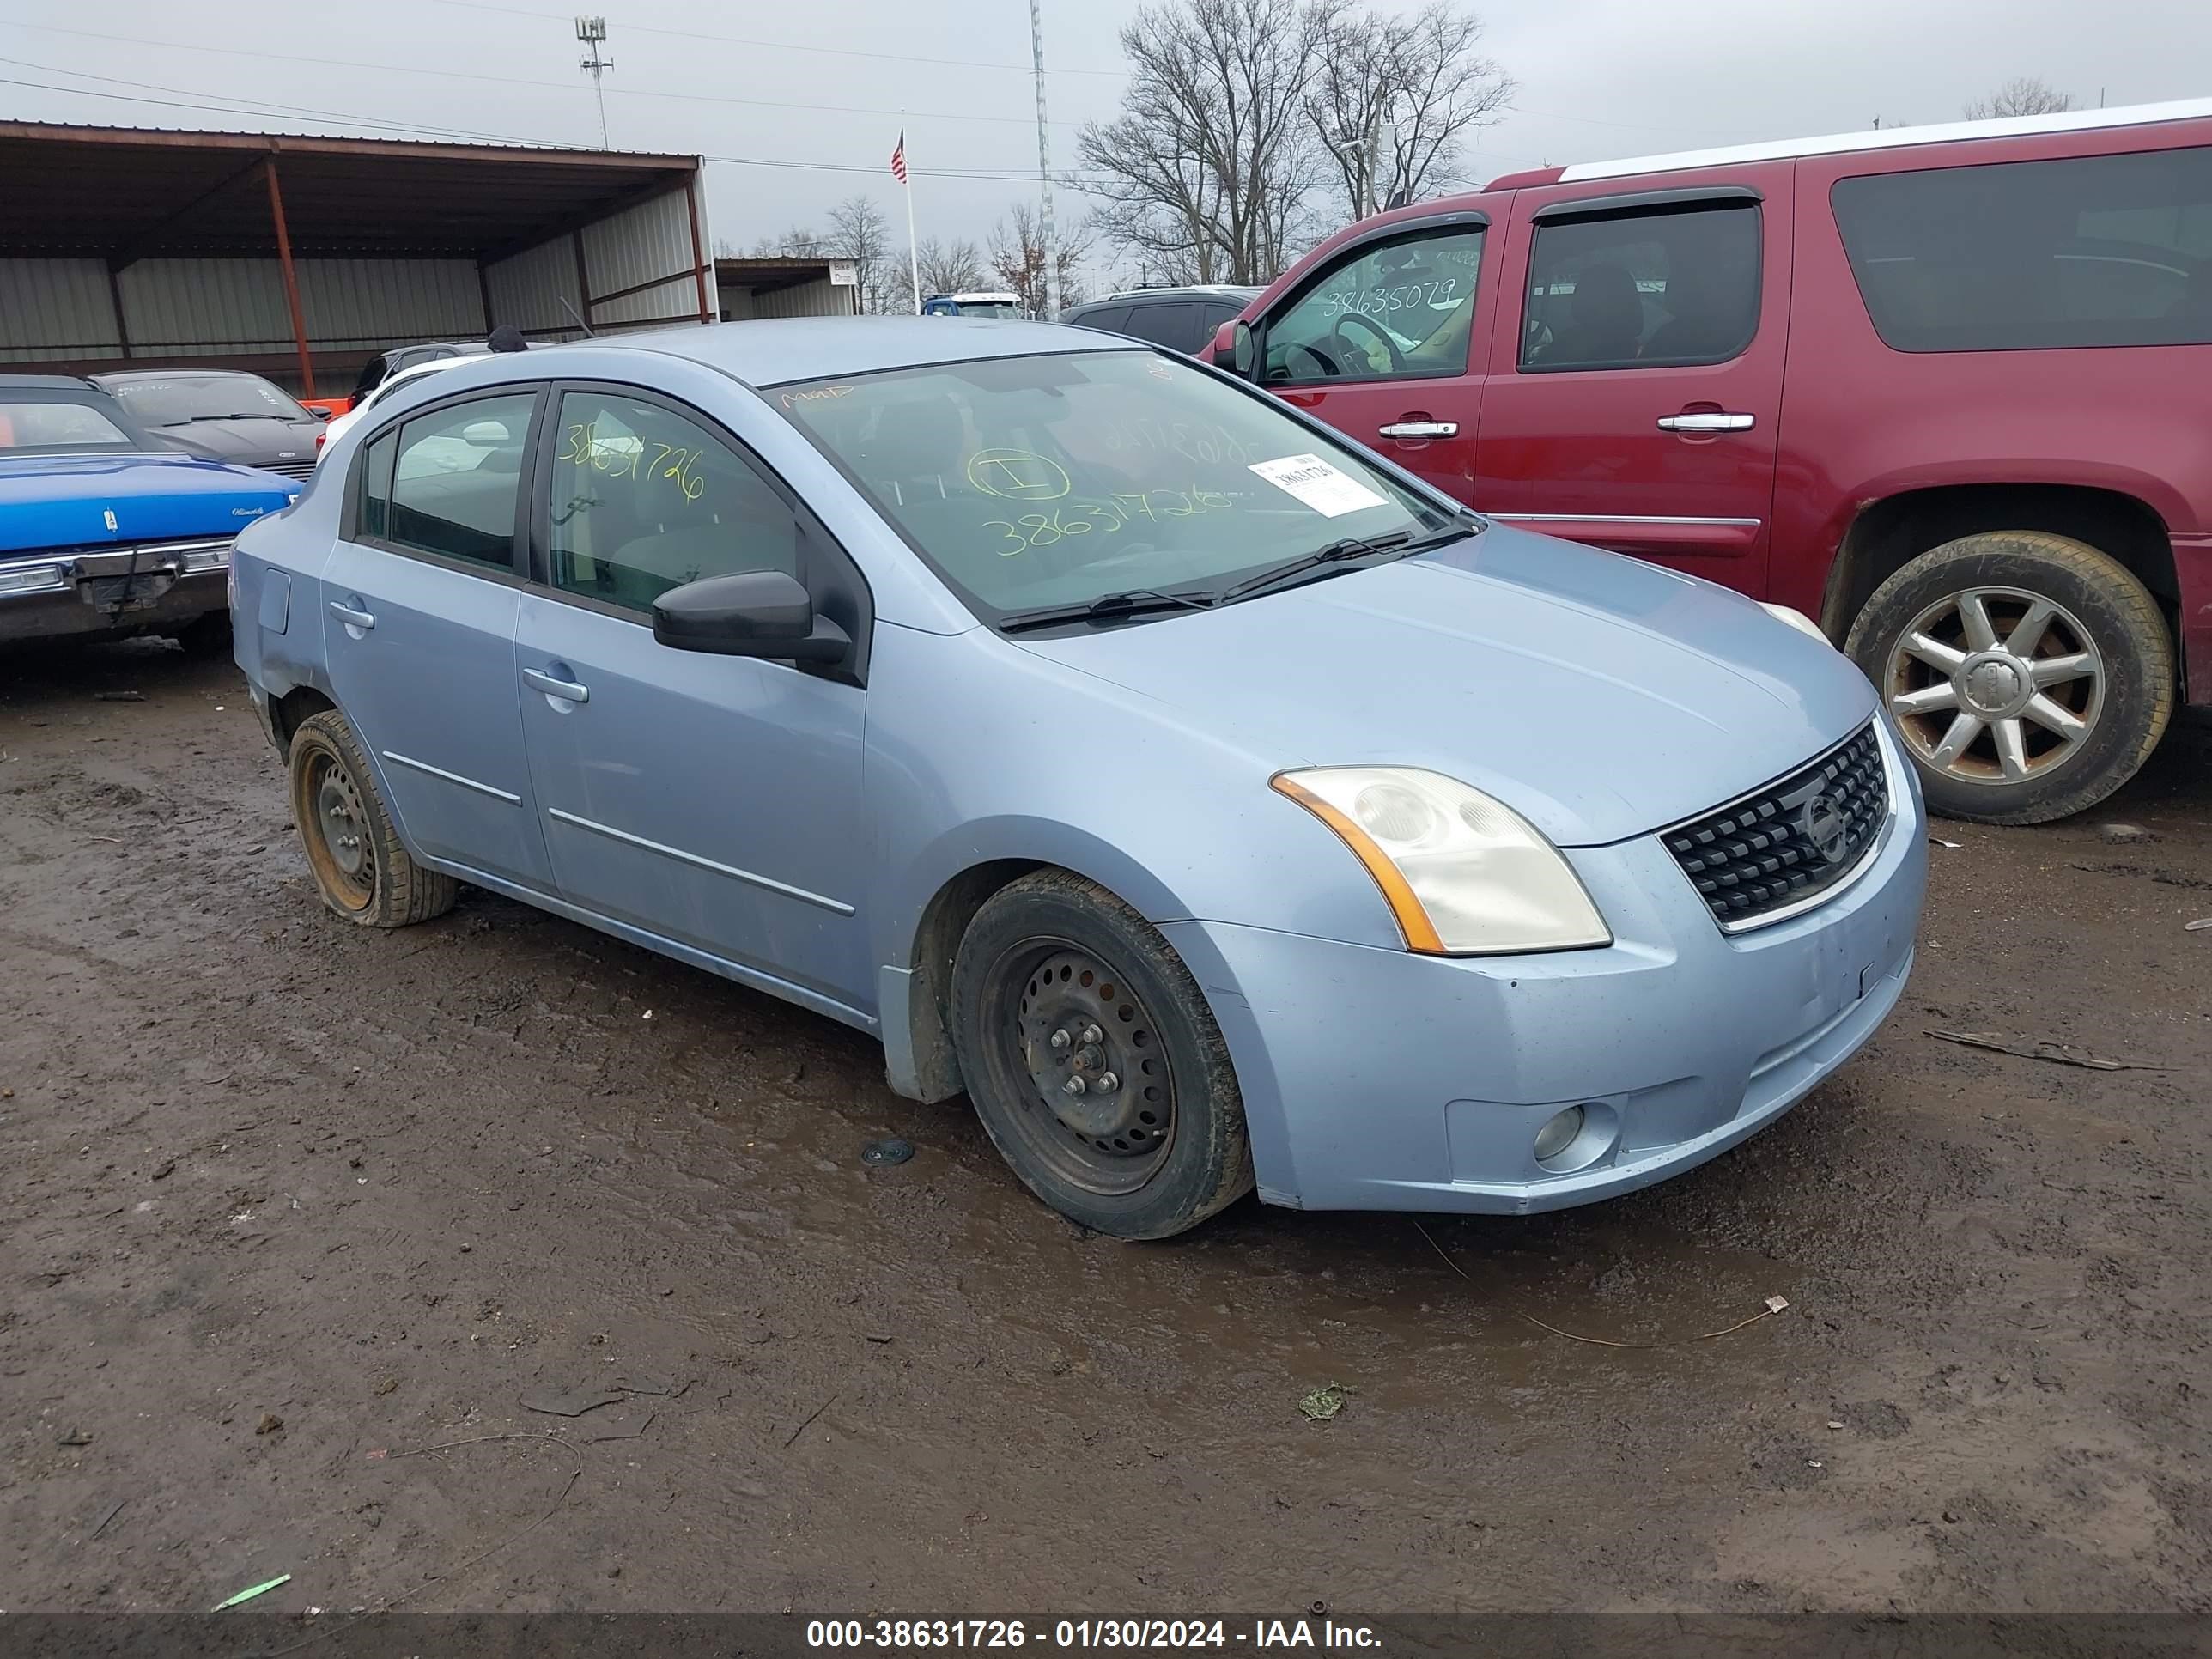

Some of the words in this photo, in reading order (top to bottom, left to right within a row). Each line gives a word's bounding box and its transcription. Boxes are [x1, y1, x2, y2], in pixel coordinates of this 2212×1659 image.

[1323, 278, 1456, 317] 38635079
[559, 422, 704, 507] 38631726
[1275, 465, 1334, 486] 38631726
[981, 483, 1232, 557] 38631726
